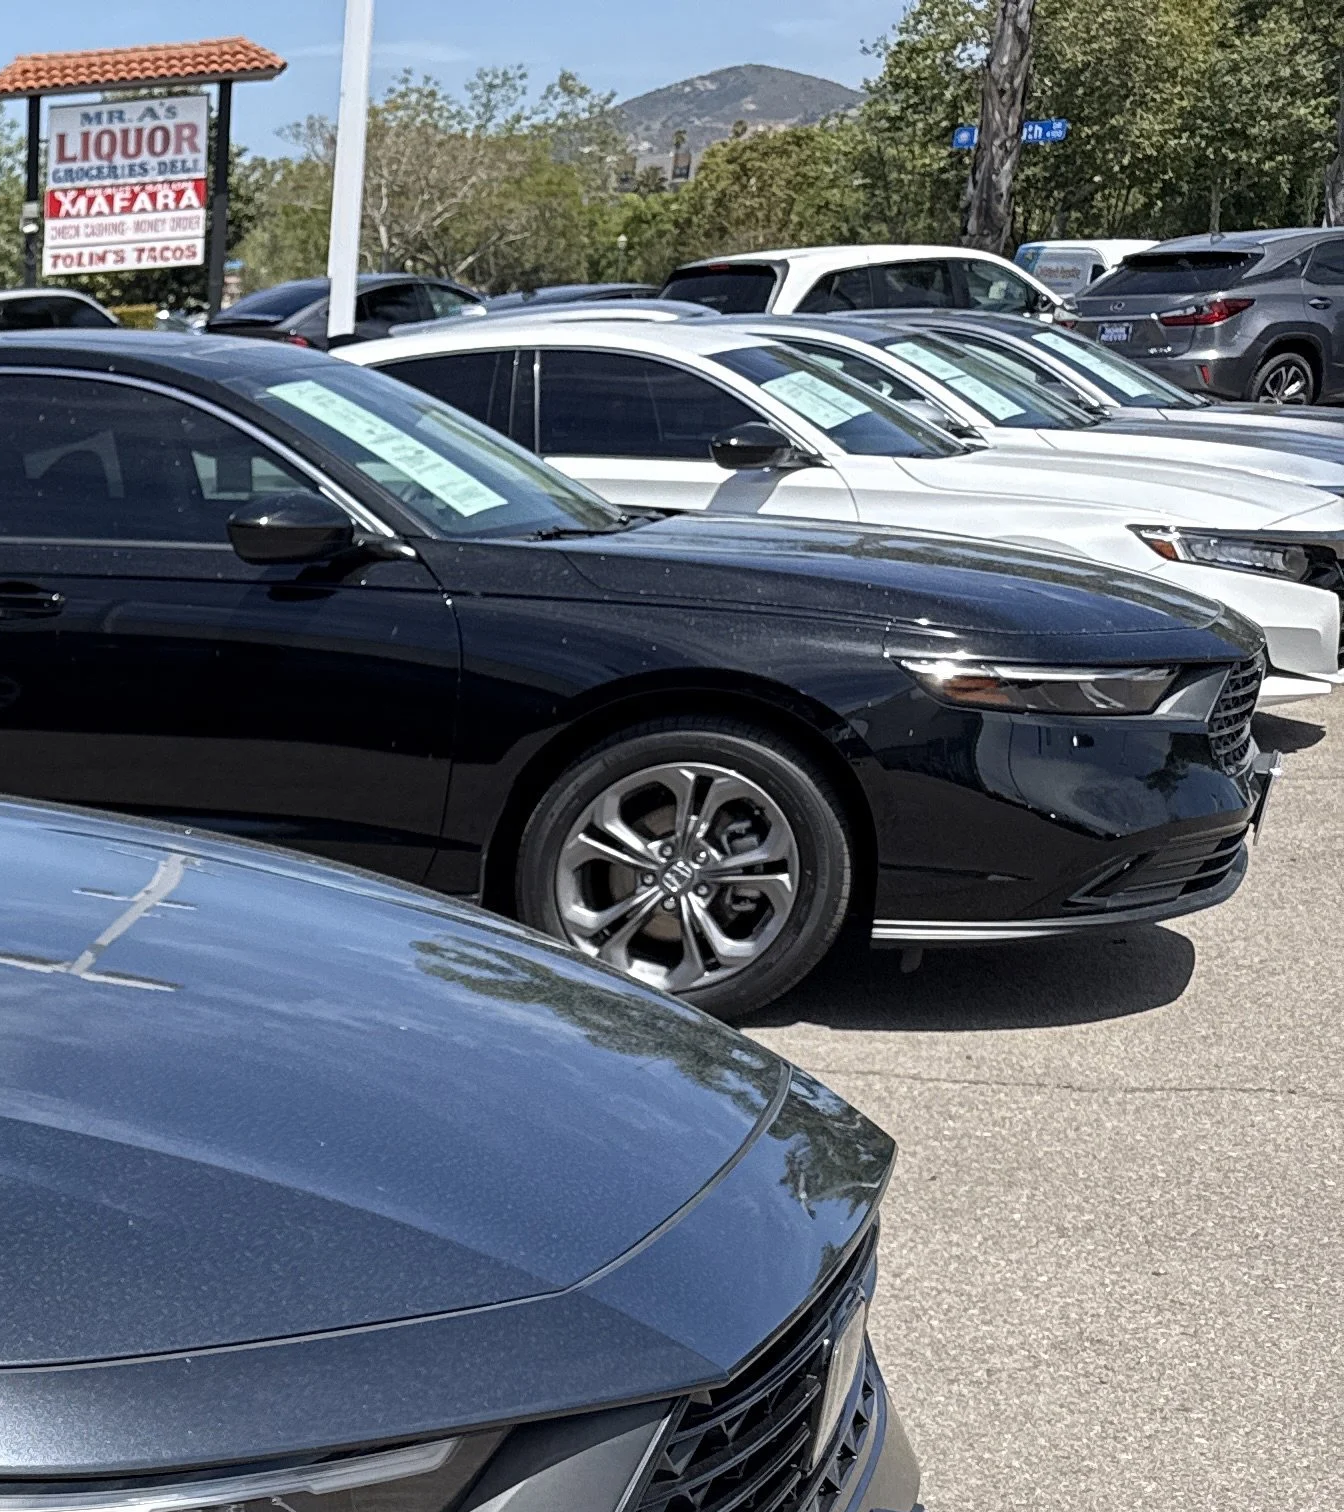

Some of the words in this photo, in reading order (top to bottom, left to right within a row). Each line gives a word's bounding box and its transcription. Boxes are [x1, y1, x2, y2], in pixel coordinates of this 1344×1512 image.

[80, 109, 133, 126] MR.
[137, 102, 178, 122] A'S
[55, 122, 201, 164] LIQUOR
[49, 248, 125, 270] TOLIN'S
[132, 243, 198, 264] TACOS
